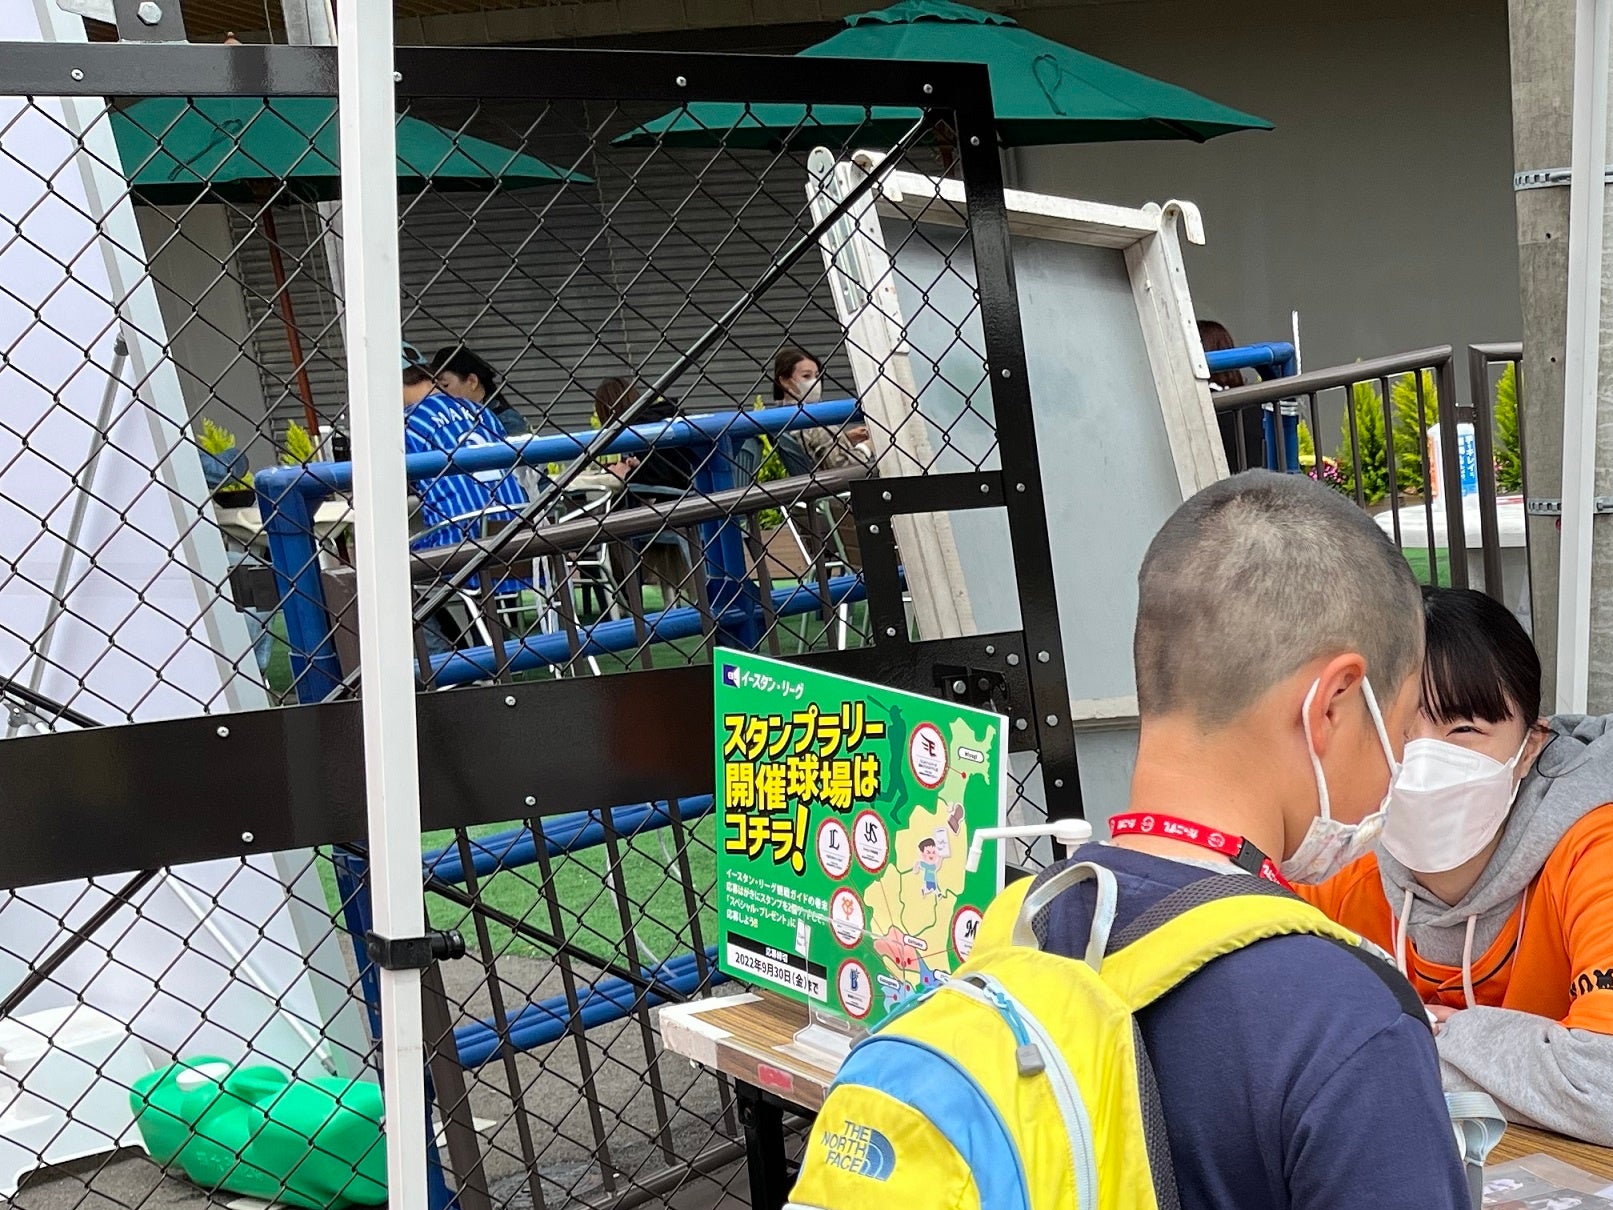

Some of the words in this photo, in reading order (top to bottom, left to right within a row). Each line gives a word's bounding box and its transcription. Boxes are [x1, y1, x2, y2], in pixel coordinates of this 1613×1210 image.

[741, 671, 804, 699] イースタン・リーグ
[724, 702, 886, 761] スタンプラリー
[724, 752, 881, 812] 開催球場は
[725, 802, 809, 873] コチラ!
[821, 1131, 867, 1158] NORTH
[844, 1120, 870, 1141] THE
[825, 1149, 863, 1173] FACE
